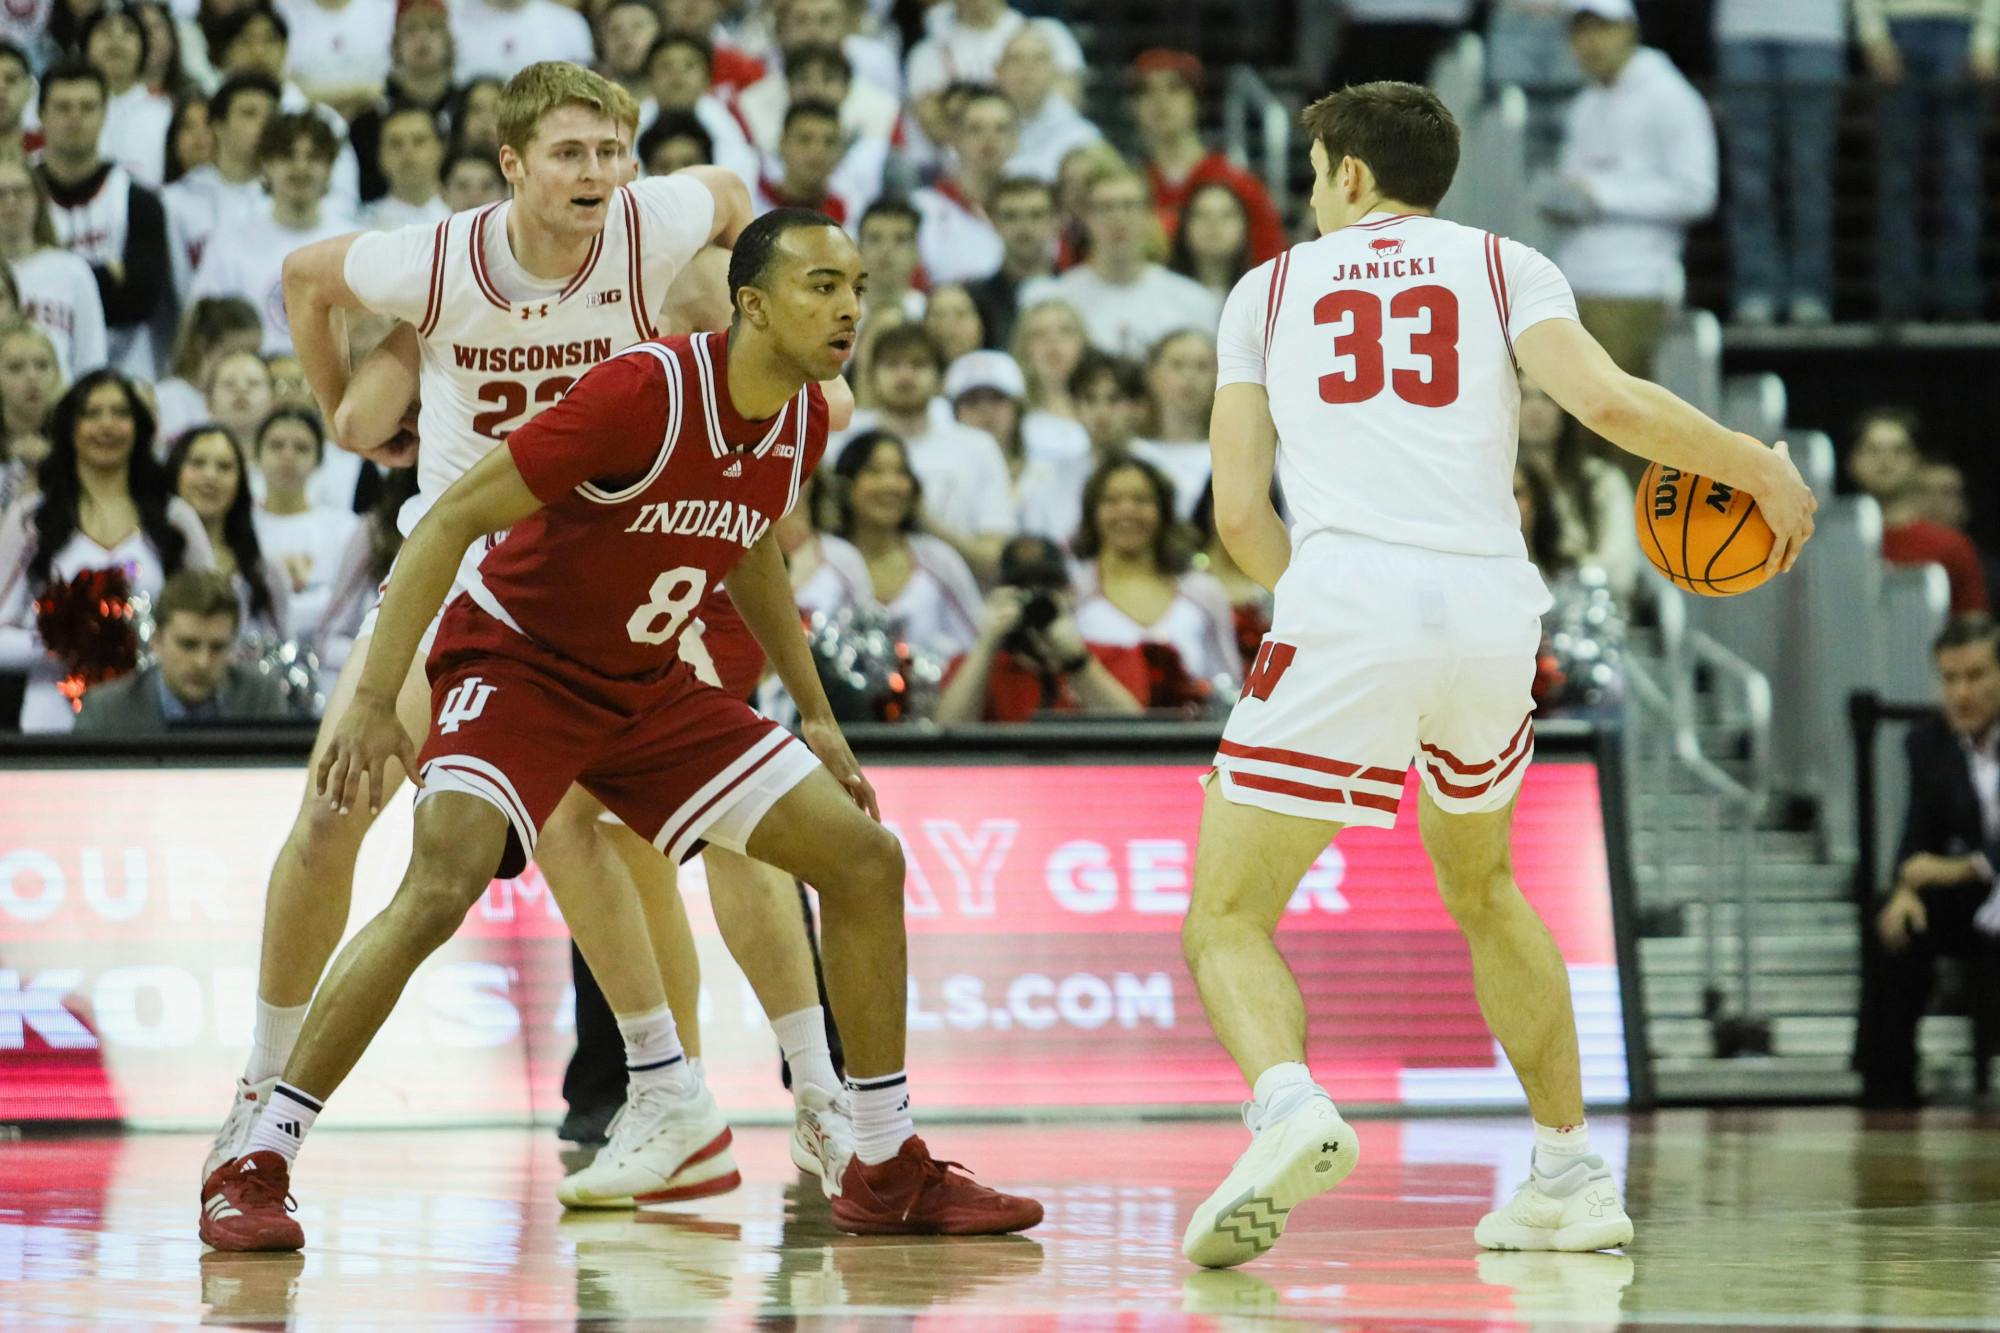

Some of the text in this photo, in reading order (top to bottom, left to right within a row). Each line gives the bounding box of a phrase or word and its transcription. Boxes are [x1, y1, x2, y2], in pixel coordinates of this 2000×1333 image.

[1333, 257, 1436, 281] JANICKI
[453, 337, 612, 372] WISCONSIN
[1313, 284, 1460, 408] 33
[625, 566, 708, 646] 8
[1045, 840, 1350, 915] GER
[907, 972, 1176, 1031] LS.COM
